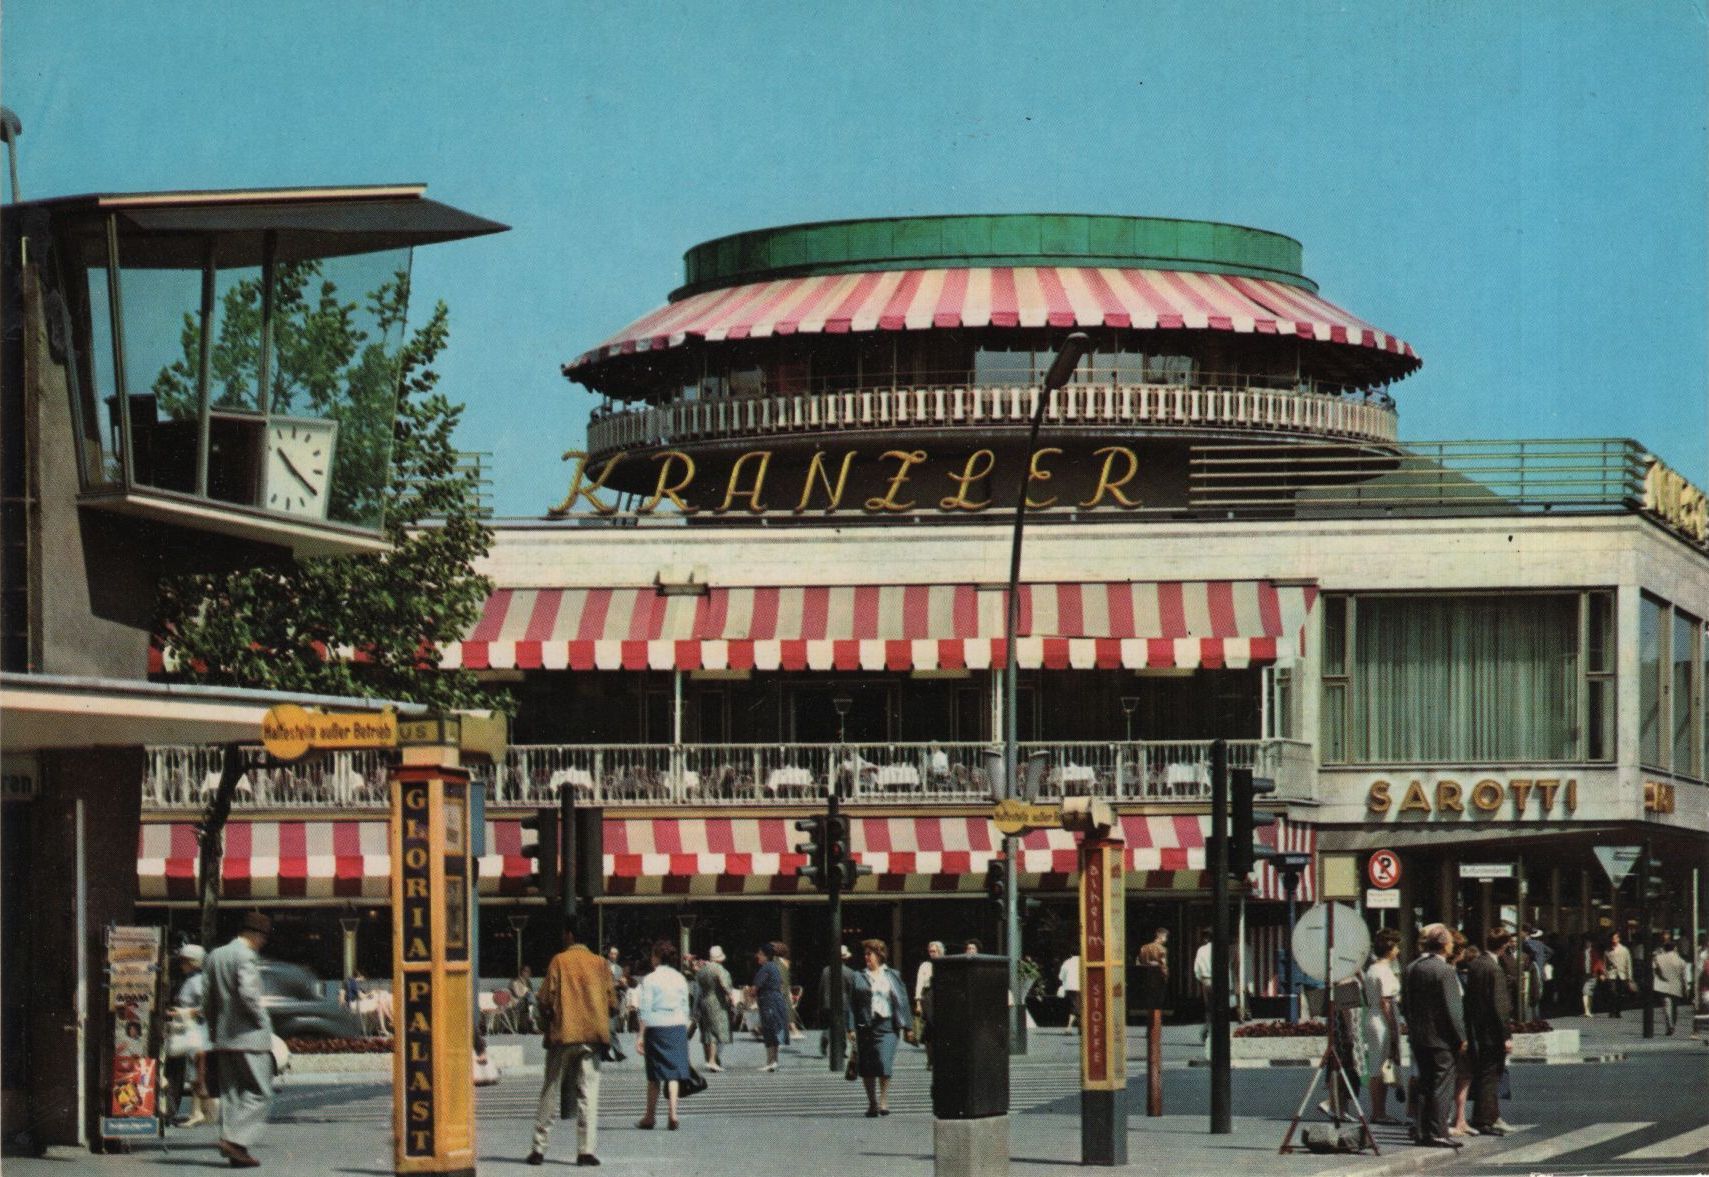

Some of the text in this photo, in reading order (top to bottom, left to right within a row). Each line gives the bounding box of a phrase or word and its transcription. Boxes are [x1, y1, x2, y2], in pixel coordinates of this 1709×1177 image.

[547, 447, 1142, 517] KRANZLER
[1368, 779, 1578, 812] SAROTTI
[405, 788, 432, 1150] GLORIA PALAST
